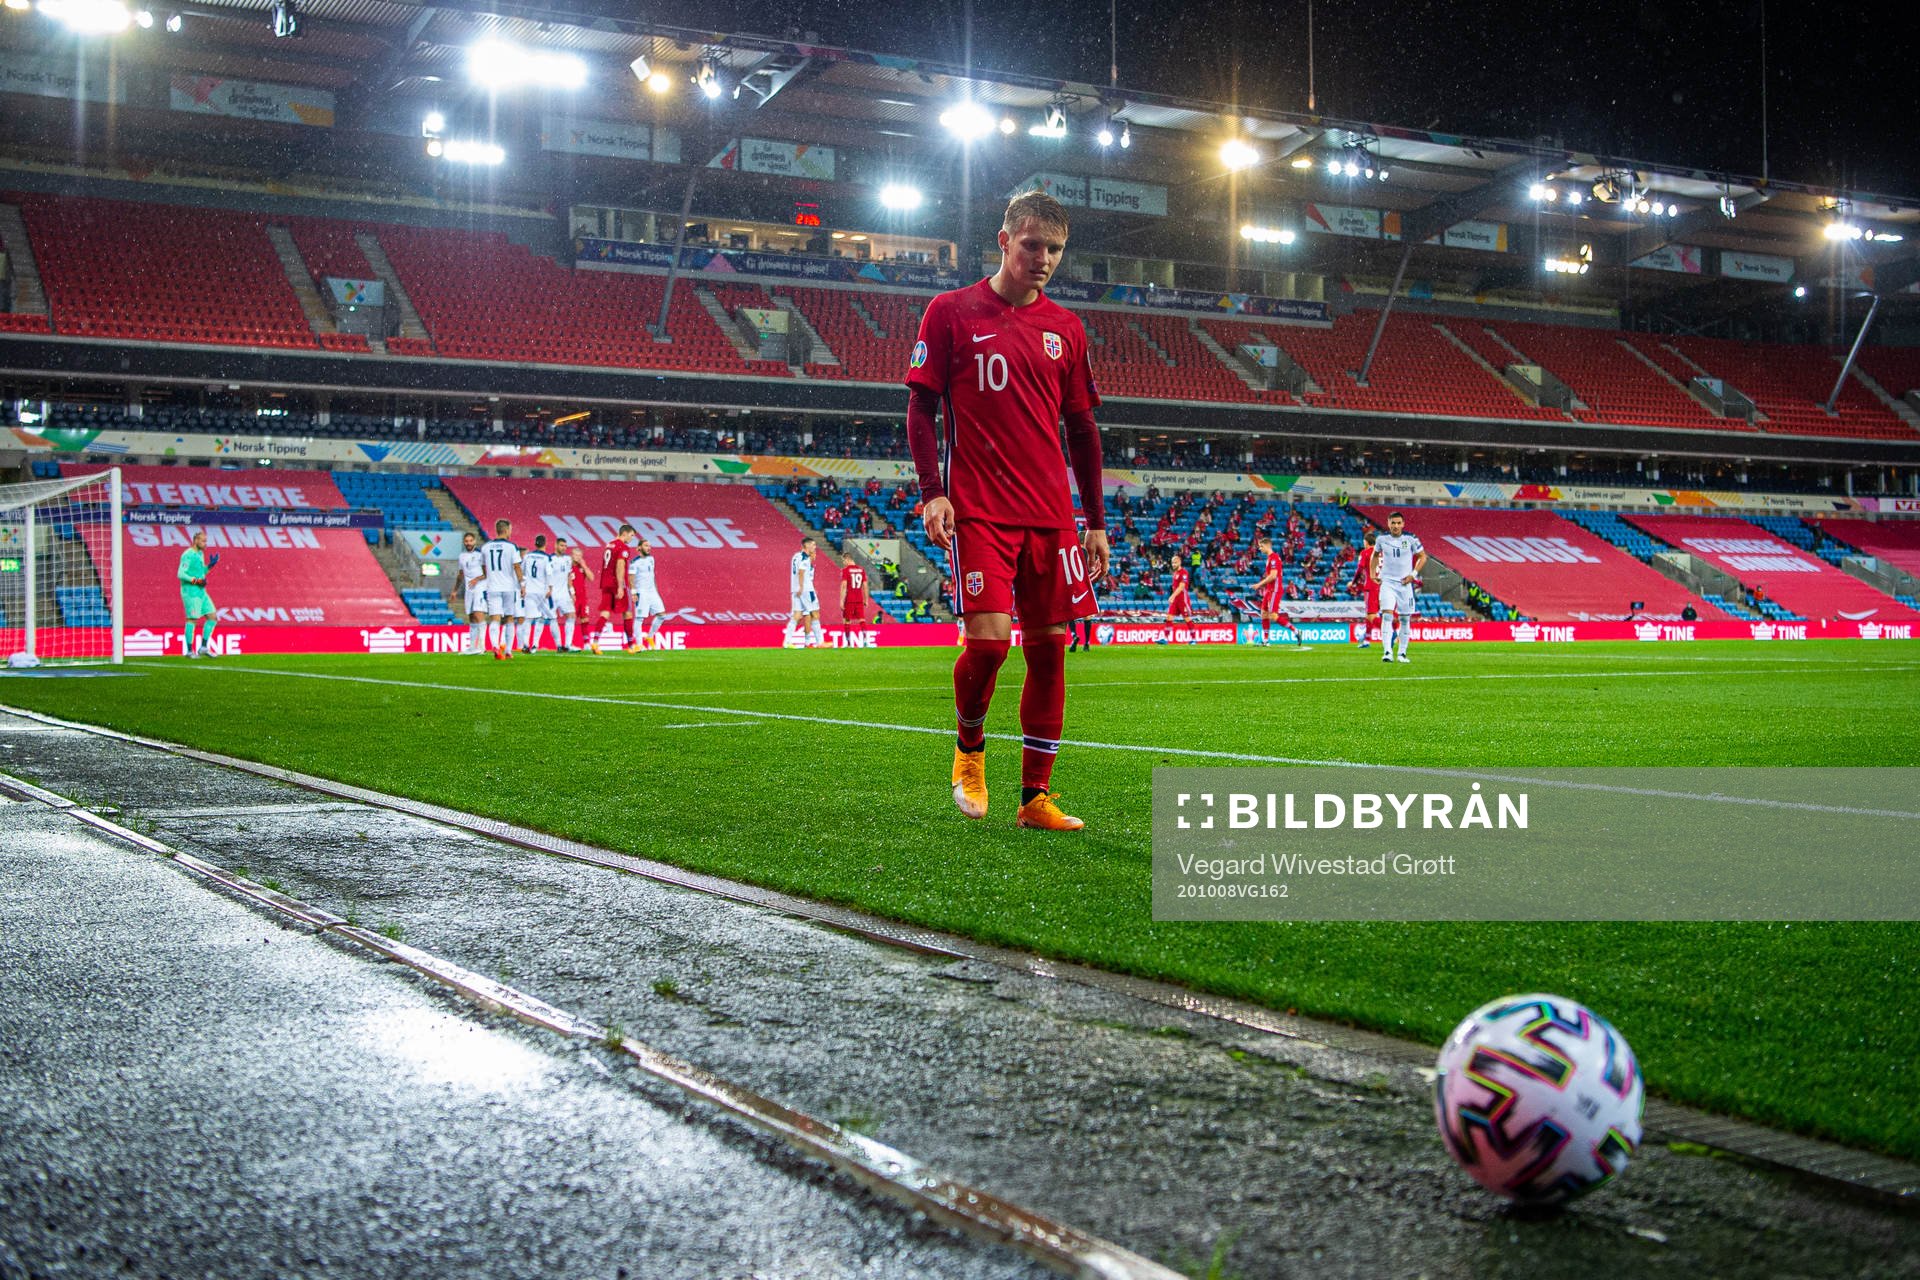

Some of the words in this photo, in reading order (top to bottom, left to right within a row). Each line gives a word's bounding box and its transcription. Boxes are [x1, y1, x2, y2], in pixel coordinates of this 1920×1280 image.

[1055, 183, 1087, 201] Nors
[1094, 188, 1140, 210] Tipping
[974, 353, 1008, 391] 10
[233, 442, 265, 452] Norsk
[267, 443, 307, 456] Tipping
[104, 483, 310, 507] STERKERE
[130, 511, 157, 521] Norsk
[157, 512, 191, 525] Tipping
[128, 525, 321, 549] SAMMEN
[540, 515, 759, 549] NORGE
[1440, 536, 1602, 563] NORGE
[489, 549, 504, 571] 17
[603, 549, 612, 569] 9
[1058, 544, 1084, 584] 10
[531, 560, 538, 578] 6
[851, 573, 863, 588] 19
[216, 607, 290, 622] KIWI
[701, 611, 794, 622] teleno
[1116, 629, 1173, 642] EUROPEAN
[1290, 629, 1319, 641] ERO
[1320, 629, 1346, 641] 2020
[1422, 628, 1474, 640] QUALIFIERS
[1541, 626, 1575, 642] TINE
[1663, 626, 1695, 641] TINE
[1777, 625, 1806, 640] TINE
[1883, 625, 1911, 640] TINE
